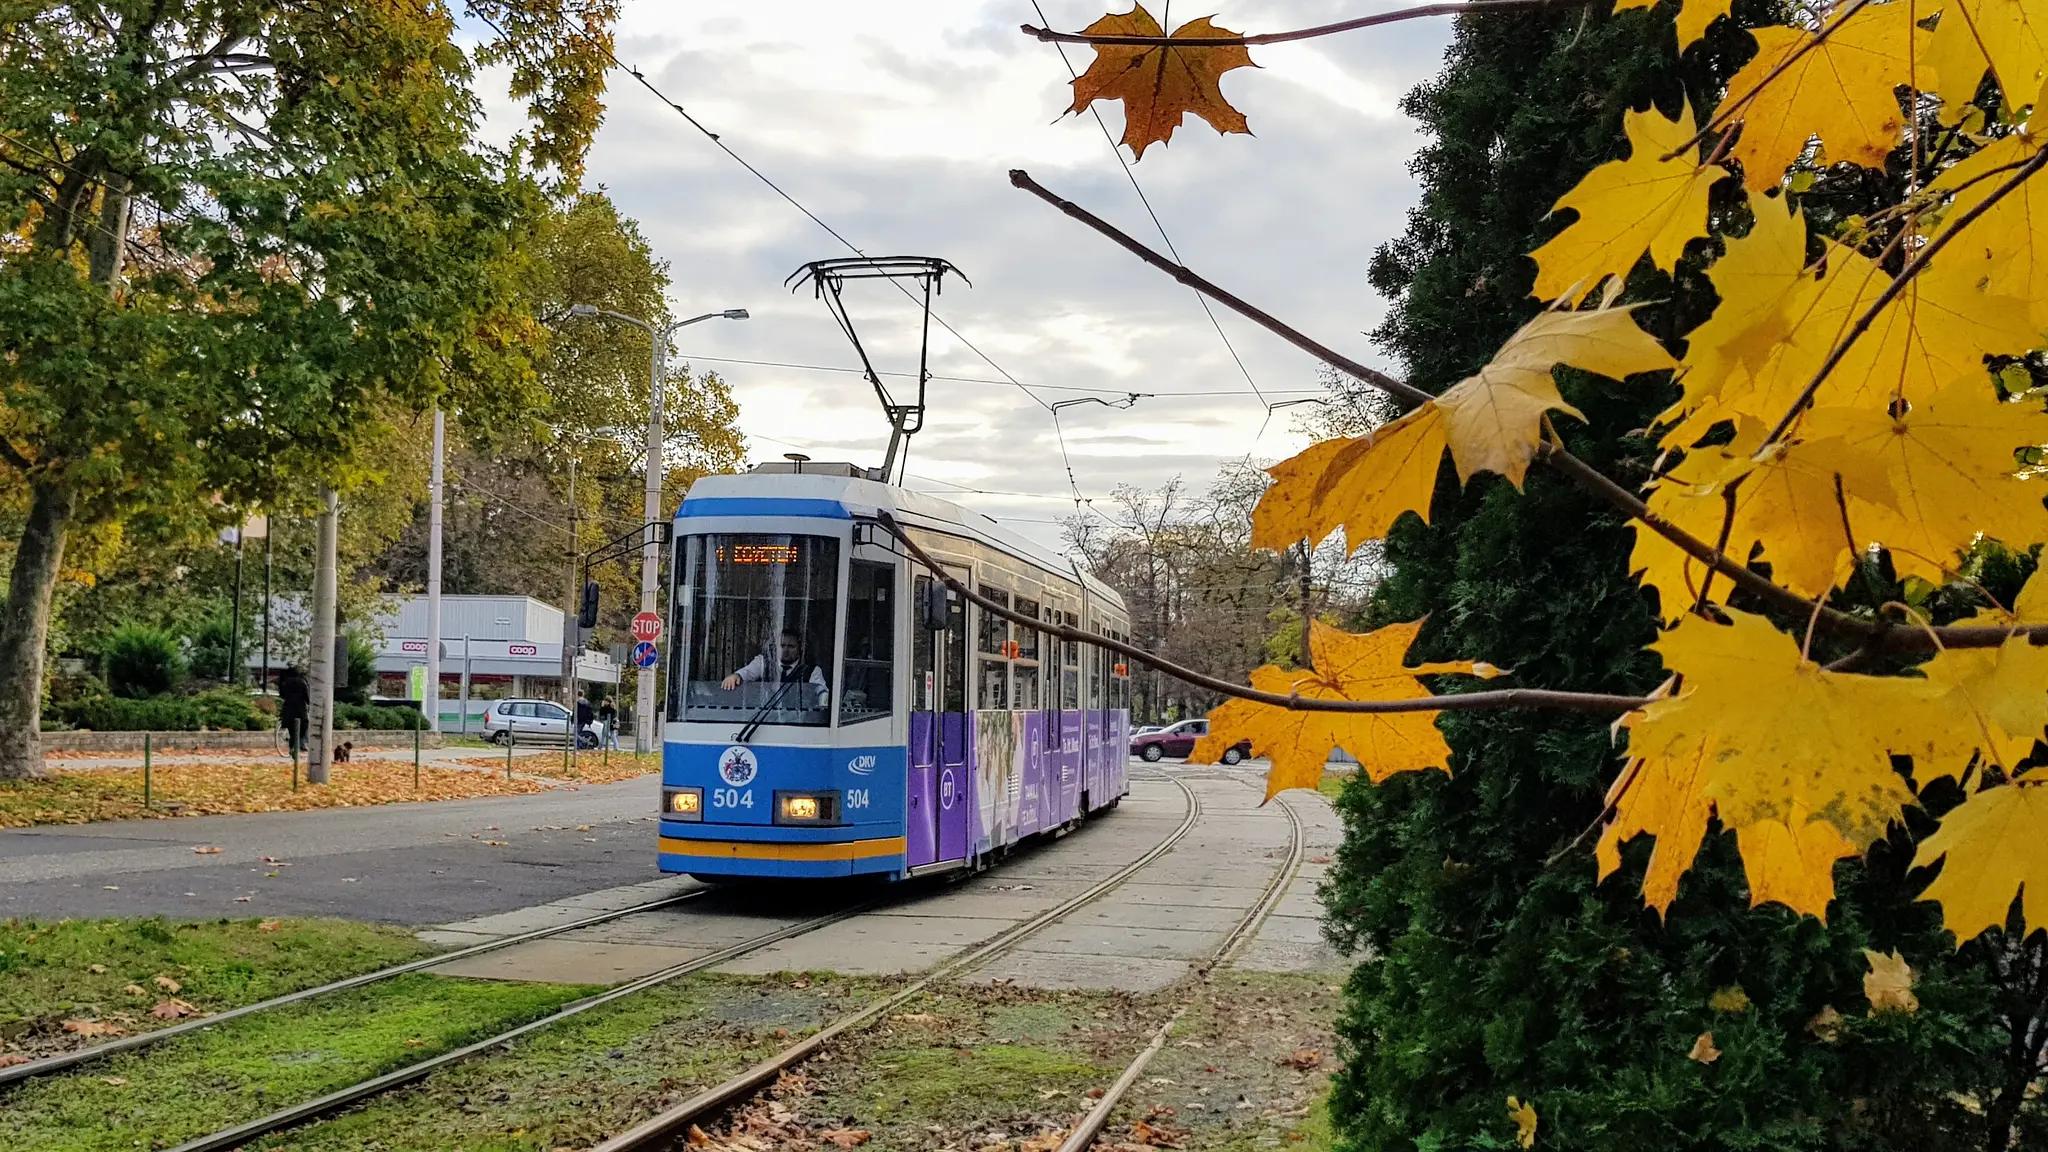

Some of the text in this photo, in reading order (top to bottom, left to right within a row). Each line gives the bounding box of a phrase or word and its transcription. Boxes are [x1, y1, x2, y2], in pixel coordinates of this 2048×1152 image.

[632, 619, 660, 634] STOP
[403, 643, 428, 654] coop
[510, 646, 535, 656] coop
[858, 755, 876, 768] DKV
[943, 781, 952, 798] BT
[713, 788, 754, 809] 504
[847, 788, 869, 809] 504
